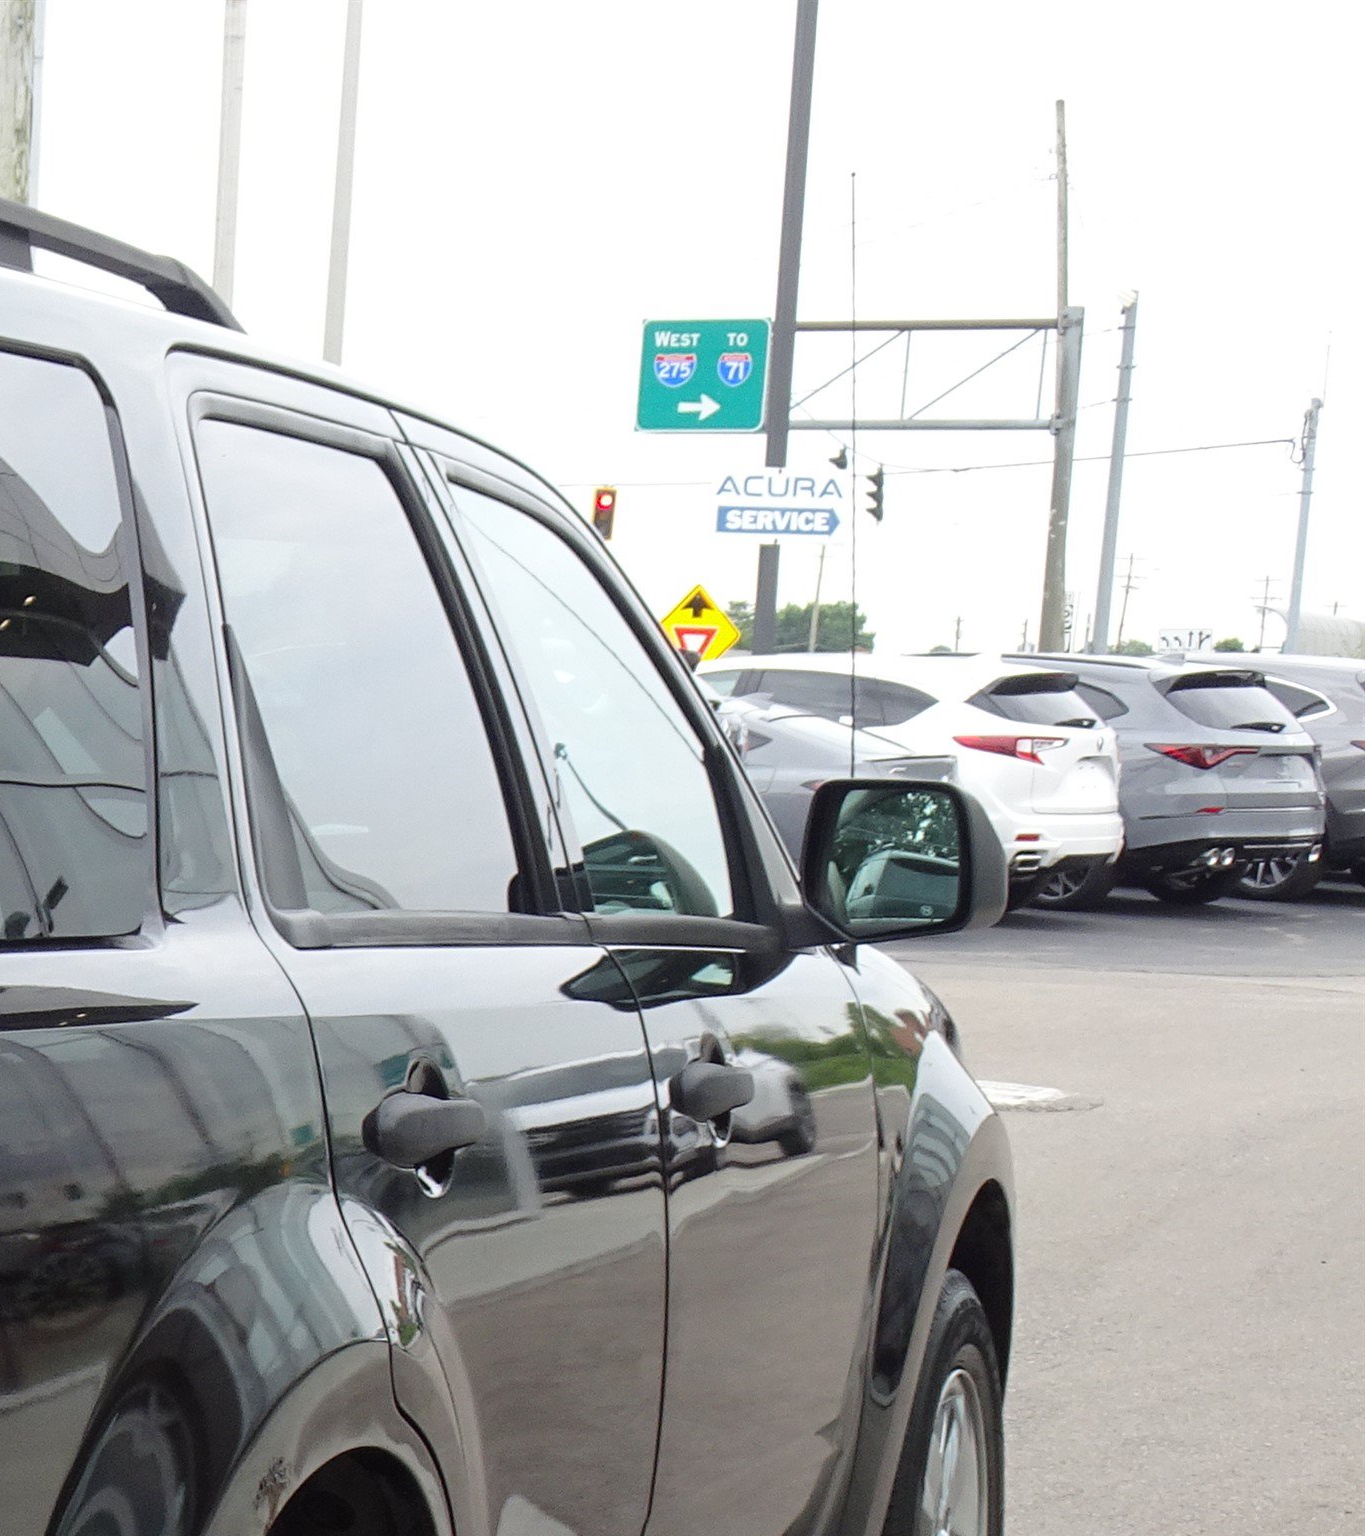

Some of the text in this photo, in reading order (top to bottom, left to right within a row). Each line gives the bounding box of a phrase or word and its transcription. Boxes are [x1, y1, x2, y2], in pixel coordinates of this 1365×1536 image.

[654, 331, 748, 347] WEST TO
[659, 361, 744, 379] 275 71
[716, 475, 843, 498] ACURA
[725, 509, 830, 532] SERVICE
